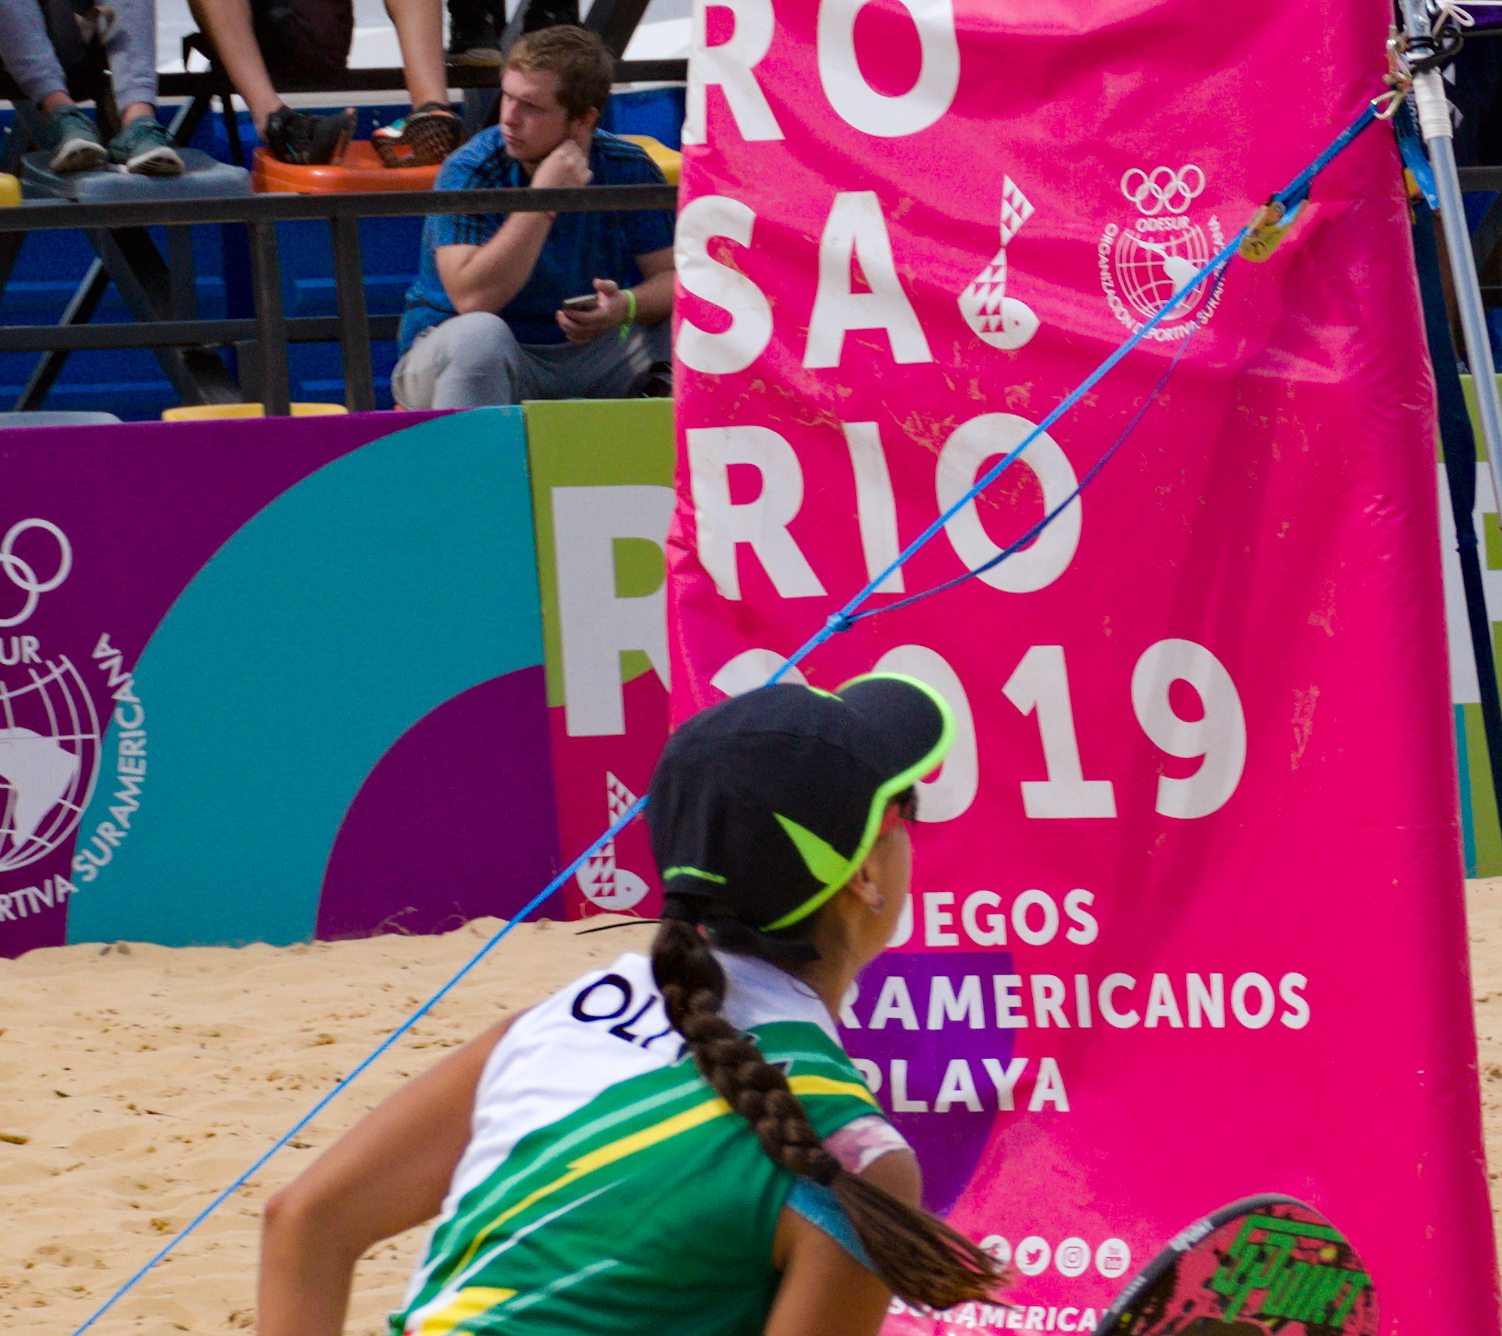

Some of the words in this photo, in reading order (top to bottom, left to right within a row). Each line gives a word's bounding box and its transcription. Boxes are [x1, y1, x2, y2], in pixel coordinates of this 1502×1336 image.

[673, 190, 934, 376] SA
[686, 412, 1084, 603] RIO
[71, 631, 148, 882] SURAMERICANA
[711, 637, 1248, 823] 019
[838, 970, 1311, 1031] RAMERICANOS
